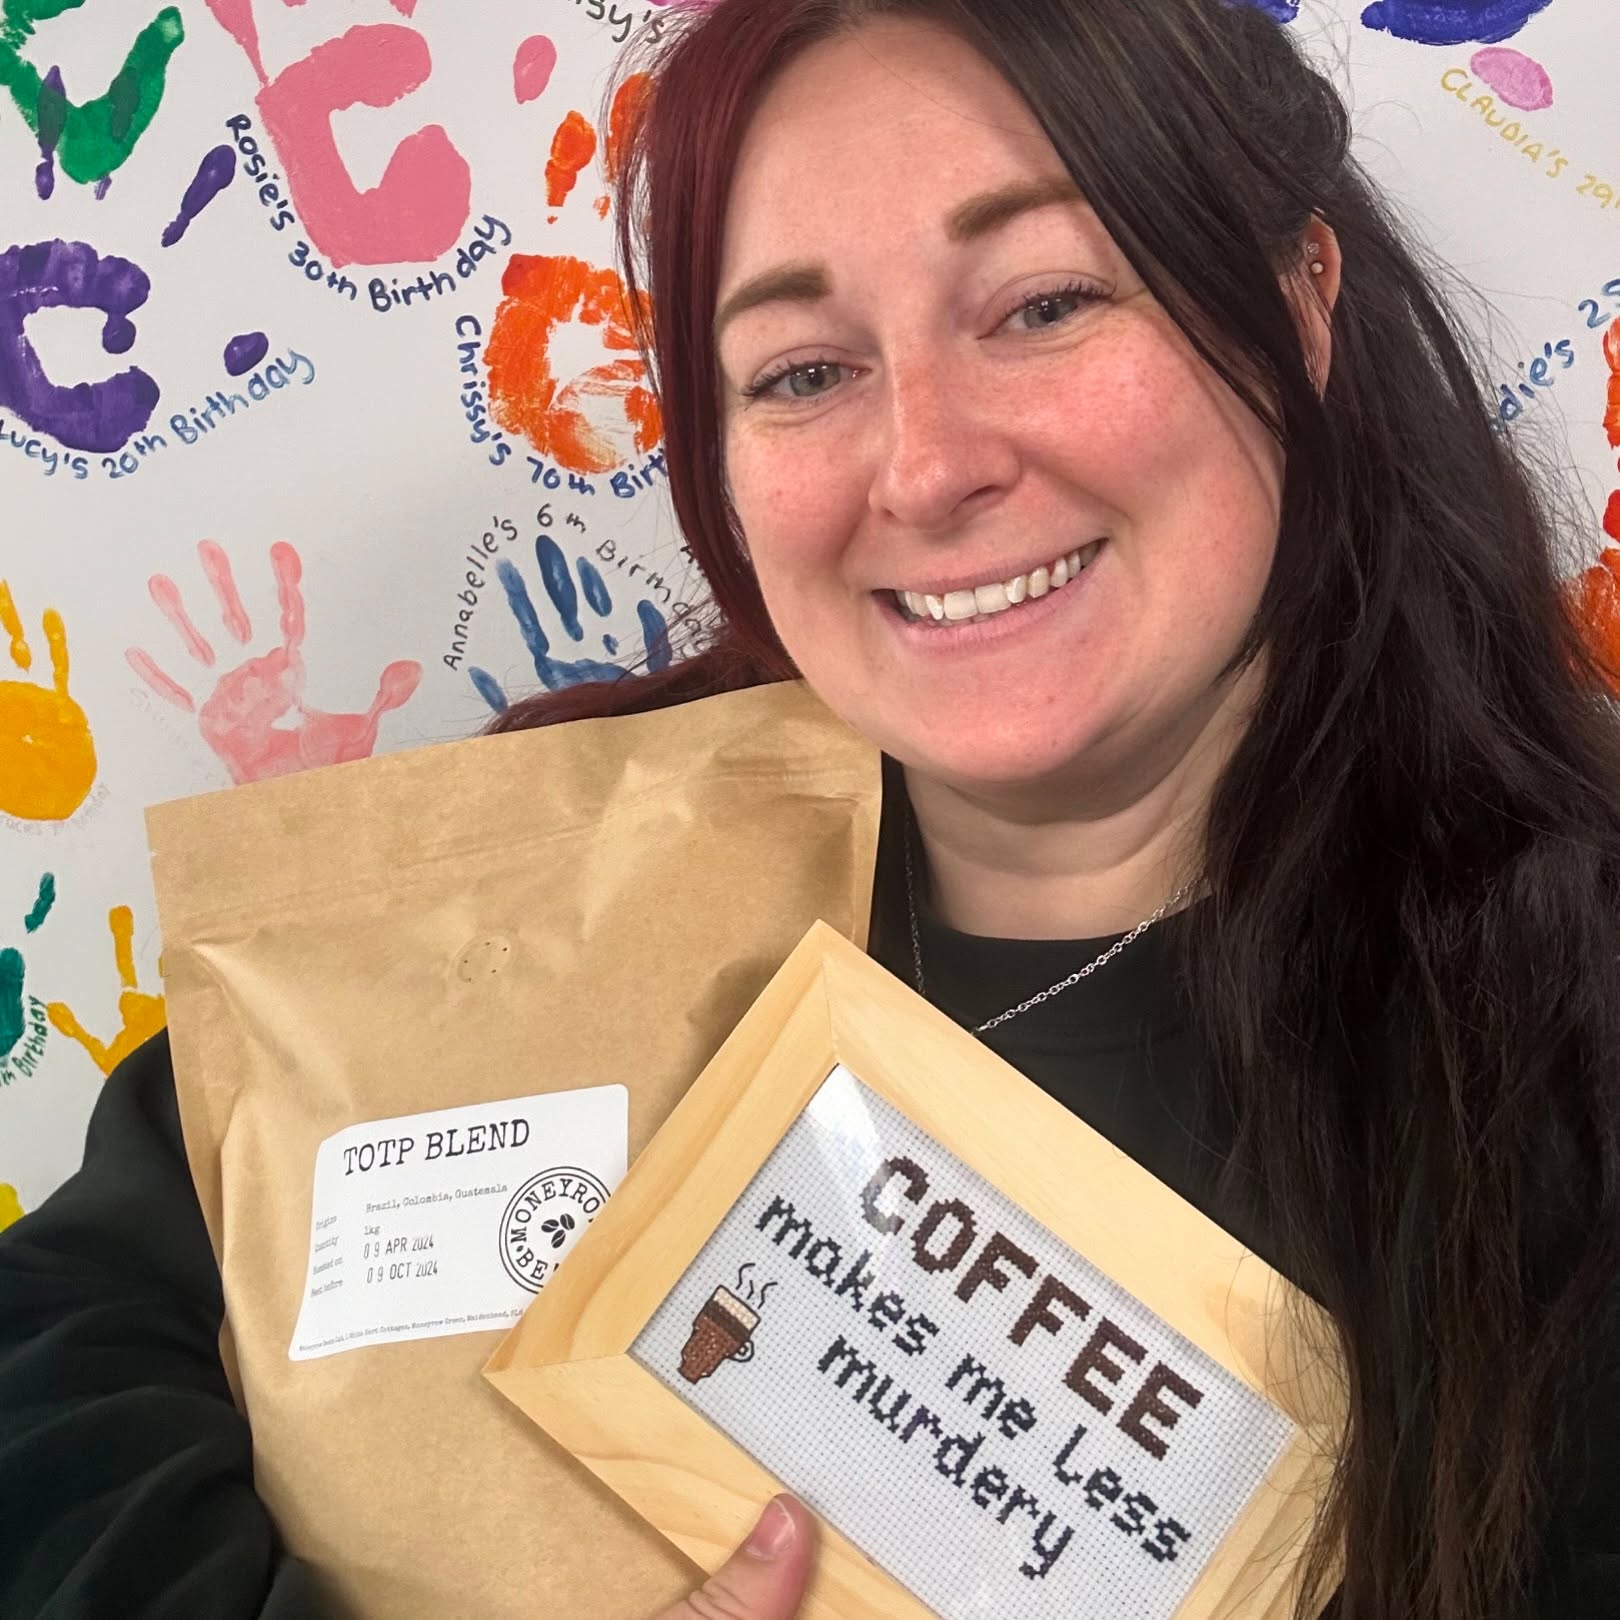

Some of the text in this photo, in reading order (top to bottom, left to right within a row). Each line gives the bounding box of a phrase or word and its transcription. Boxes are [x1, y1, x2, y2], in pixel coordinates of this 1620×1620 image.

[568, 0, 664, 43] sy's
[1440, 68, 1568, 178] CLAUDIA'S
[225, 113, 512, 312] Rosie's 30th Birthday
[101, 434, 167, 479] 20th
[170, 348, 315, 444] Birthday
[455, 315, 668, 498] Chrissy's 70th Birt
[443, 516, 518, 671] Annabelle's
[11, 995, 48, 1078] Birthday
[343, 1118, 530, 1176] TOTP BLEND
[385, 1237, 408, 1255] APR
[412, 1234, 434, 1252] 2024
[510, 1178, 601, 1244] MONEYRO
[515, 1247, 559, 1281] BE
[389, 1262, 412, 1280] OCT
[416, 1260, 438, 1278] 2024
[860, 1156, 1205, 1462] COFFEE
[755, 1195, 1192, 1563] makes me less
[816, 1334, 1076, 1580] murdery
